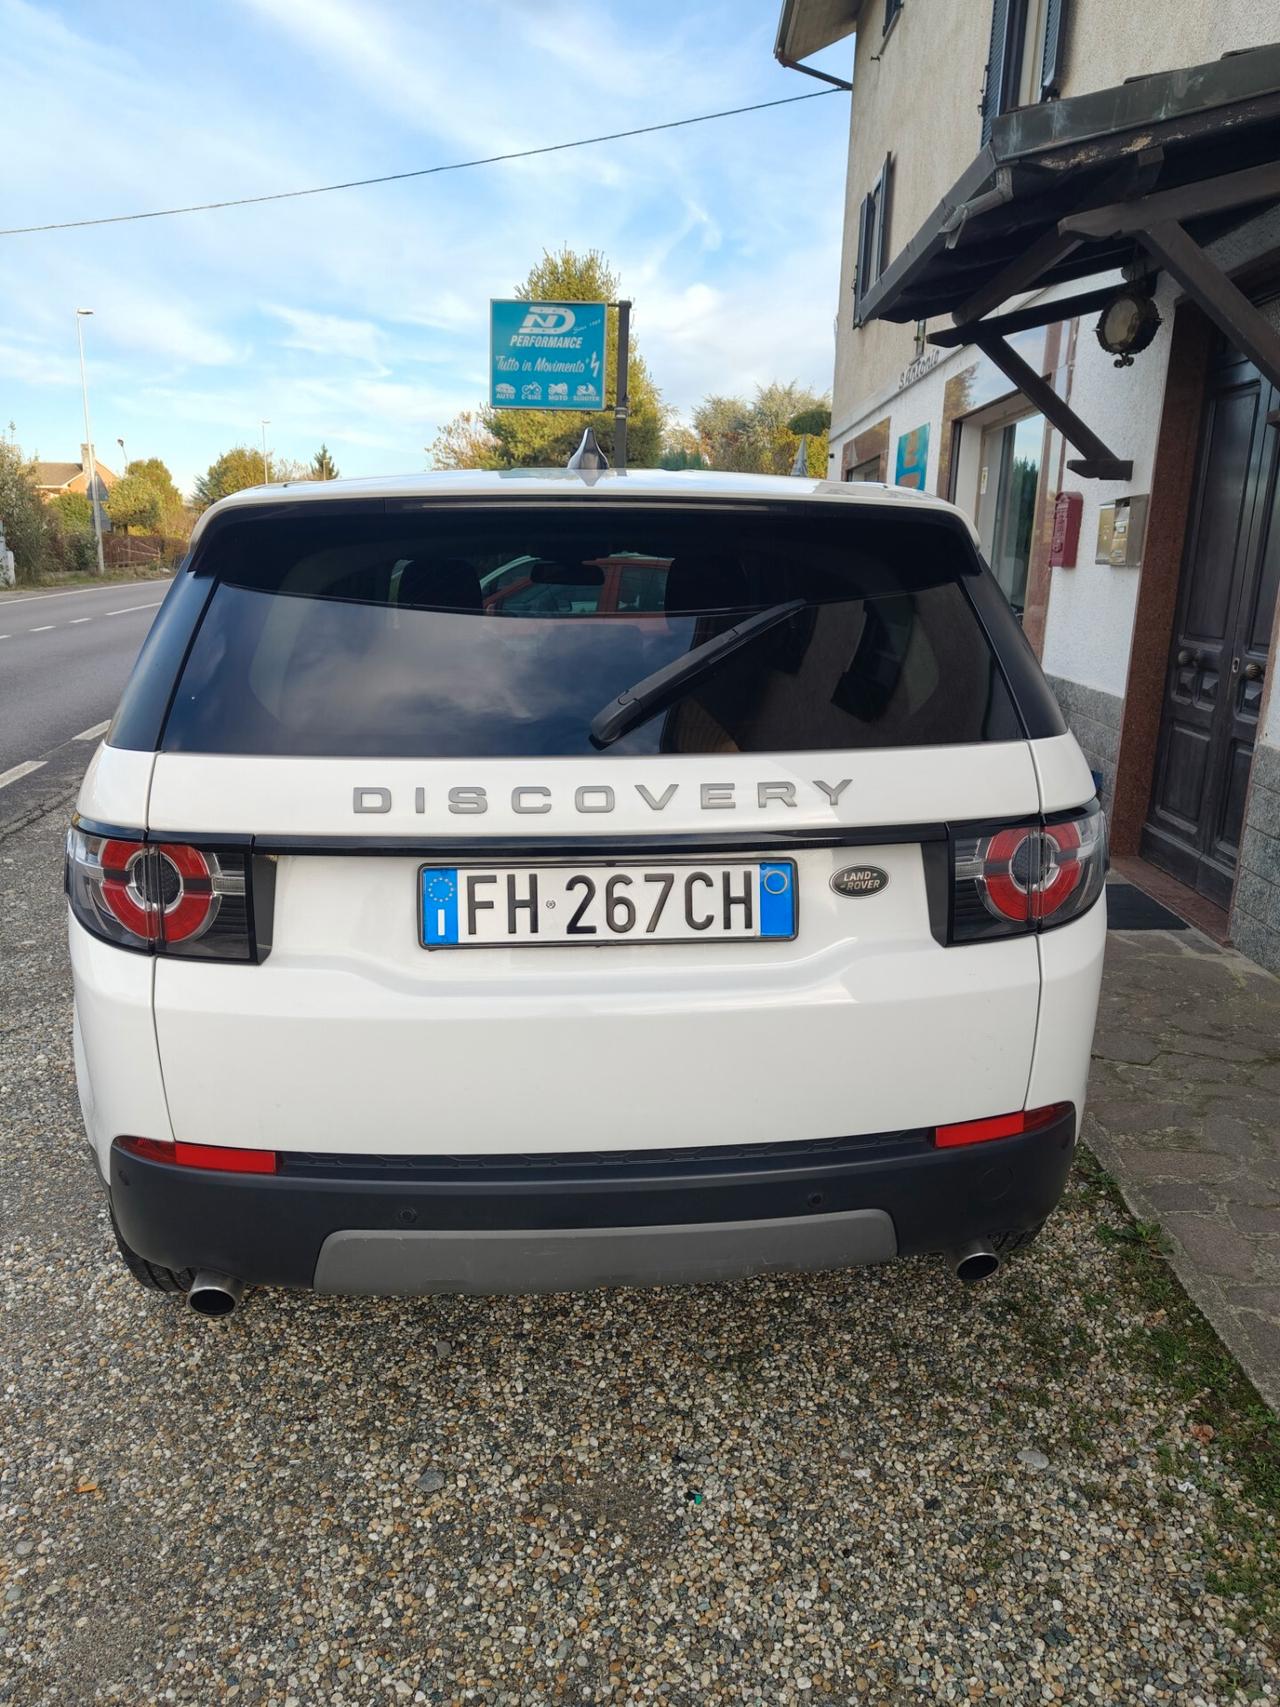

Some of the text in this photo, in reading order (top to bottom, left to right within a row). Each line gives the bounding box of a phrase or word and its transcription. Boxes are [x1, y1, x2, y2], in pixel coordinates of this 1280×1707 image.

[509, 335, 583, 349] PERFORMANCE
[522, 360, 532, 372] in
[353, 778, 854, 814] DISCOVERY
[466, 870, 753, 936] FH 267CH
[437, 909, 446, 936] I
